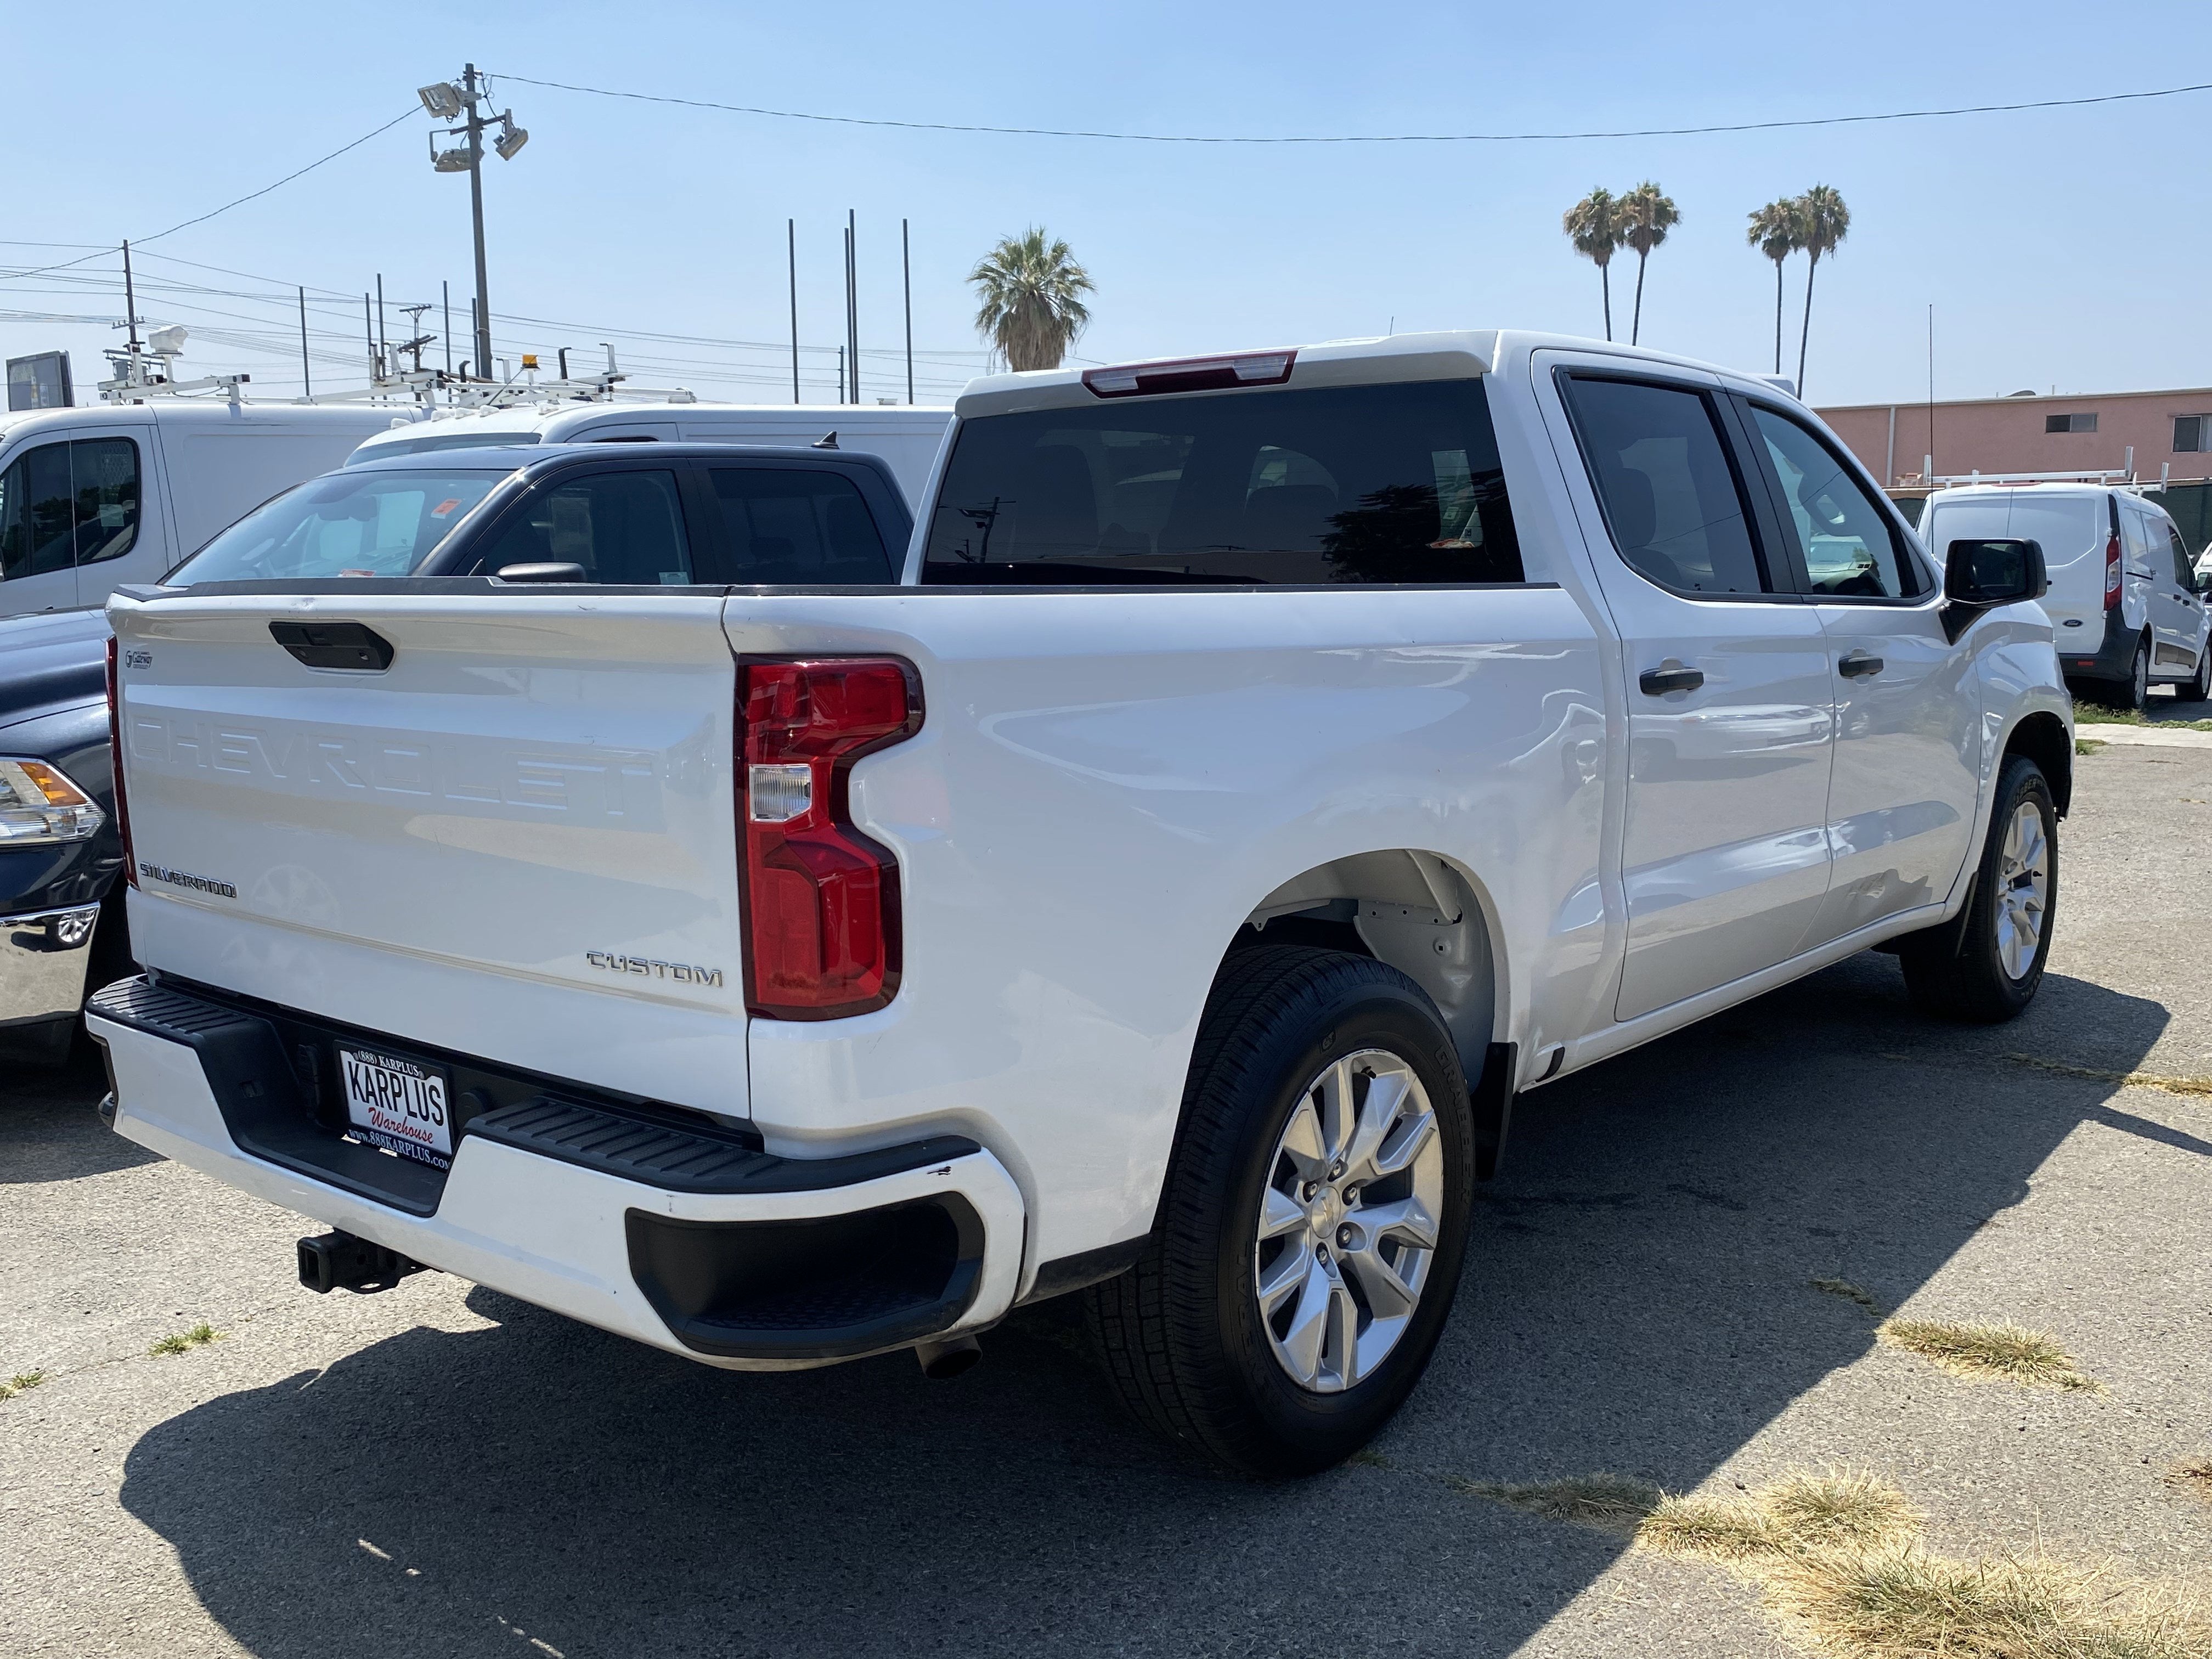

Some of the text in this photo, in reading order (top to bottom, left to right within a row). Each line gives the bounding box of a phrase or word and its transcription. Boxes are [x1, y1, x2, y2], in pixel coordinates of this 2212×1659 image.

[132, 716, 653, 815] CHEVROLET
[140, 862, 237, 898] SILVERADO
[586, 950, 723, 988] CUSTOM
[358, 1050, 419, 1076] (888) KARPLUS
[348, 1060, 444, 1126] KARPLUS
[368, 1107, 433, 1144] Warehouse
[1434, 1045, 1472, 1205] GRABBER
